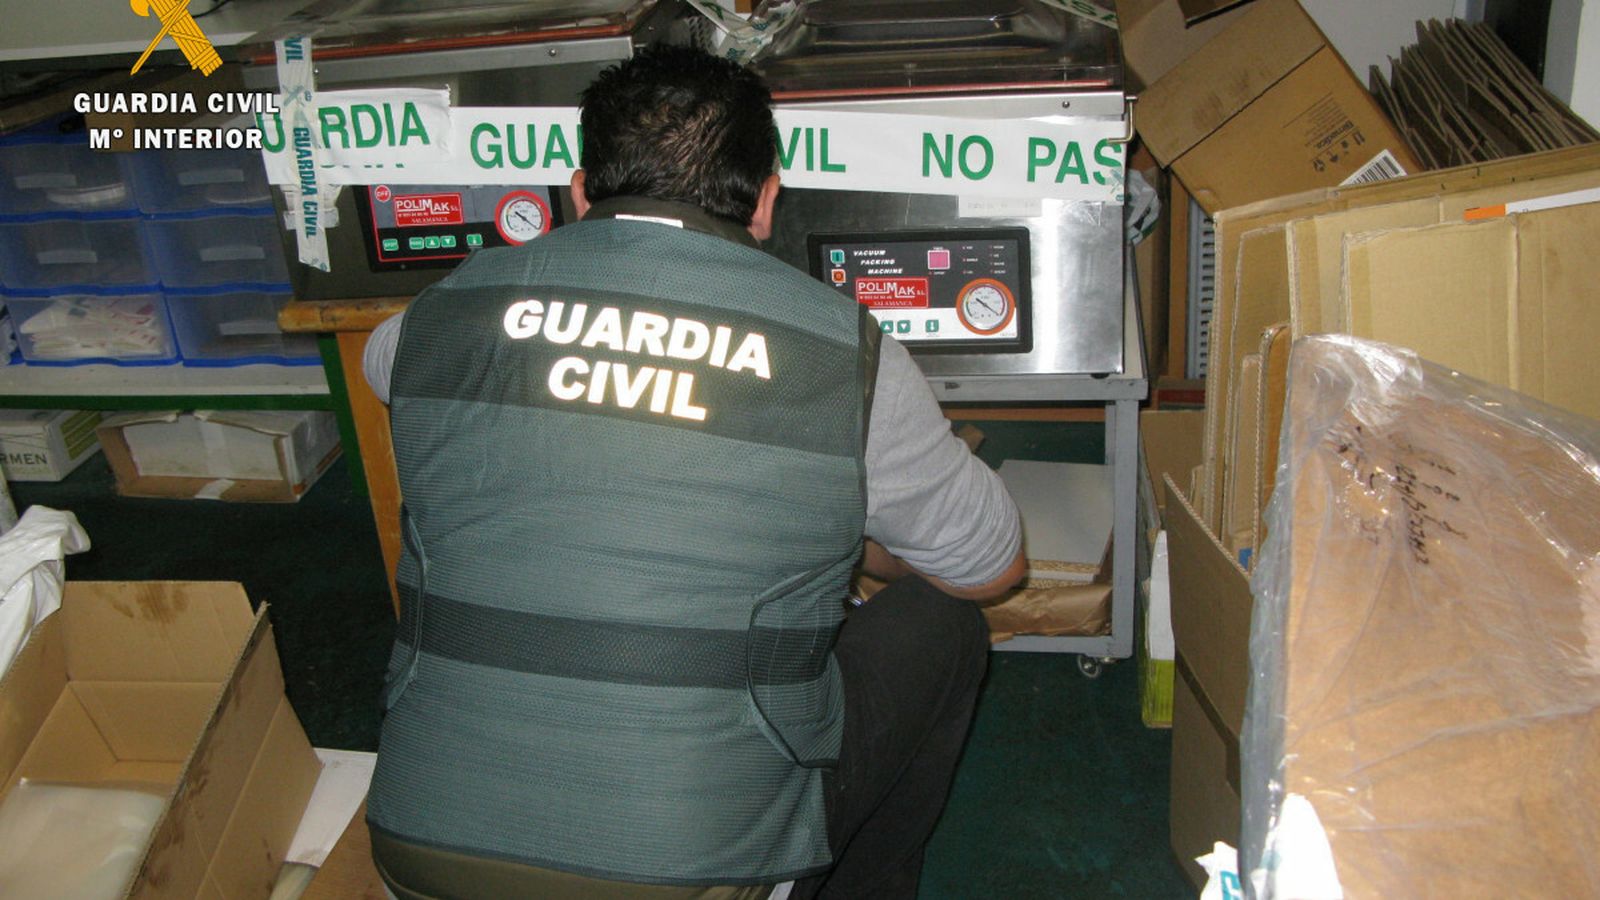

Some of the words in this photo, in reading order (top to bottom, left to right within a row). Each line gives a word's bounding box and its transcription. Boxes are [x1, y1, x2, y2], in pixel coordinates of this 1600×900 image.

[293, 127, 318, 197] GUARDIA
[922, 132, 994, 181] NO
[302, 200, 319, 239] CIVIL
[503, 299, 771, 379] GUARDIA
[548, 356, 707, 421] CIVIL
